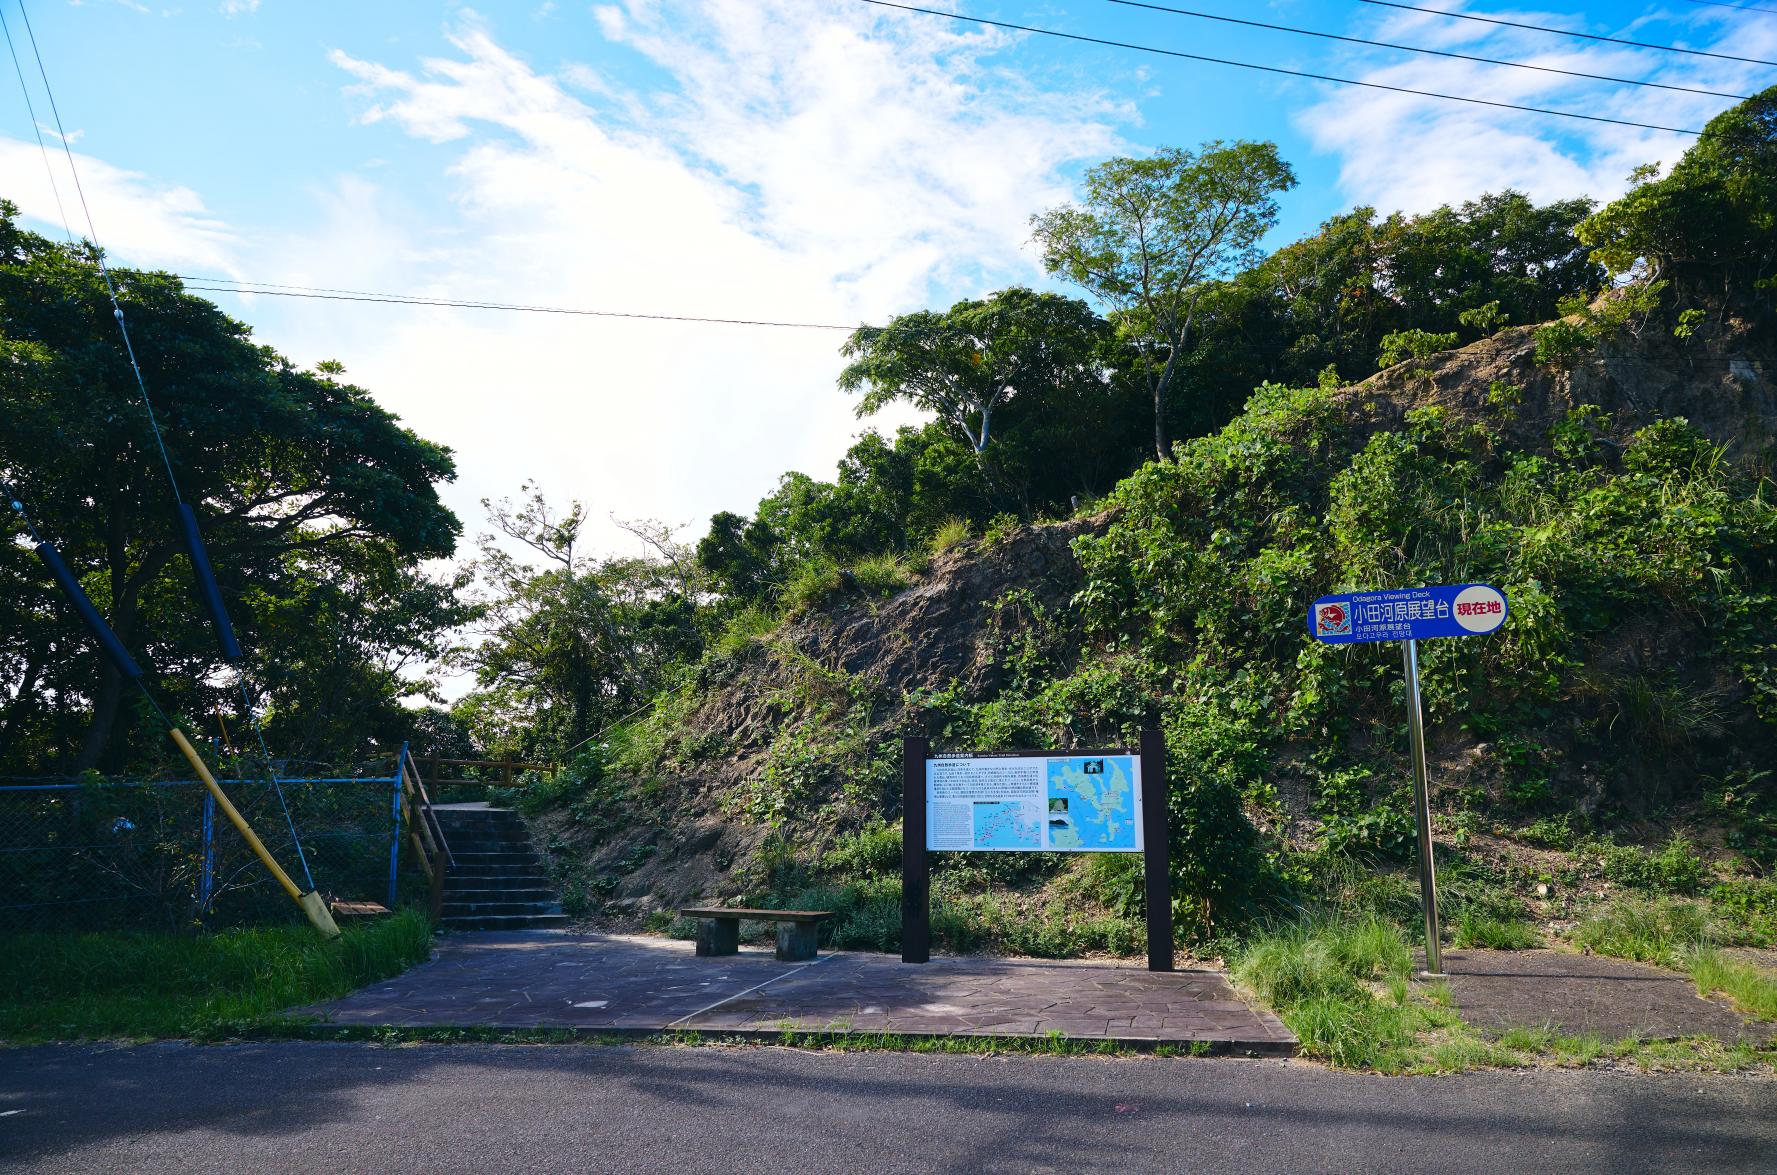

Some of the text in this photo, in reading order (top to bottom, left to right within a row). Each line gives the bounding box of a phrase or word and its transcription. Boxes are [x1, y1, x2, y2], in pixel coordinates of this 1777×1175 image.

[1383, 592, 1411, 600] Viewing
[1354, 598, 1449, 624] 小田河原展望台
[1456, 600, 1502, 616] 現在地
